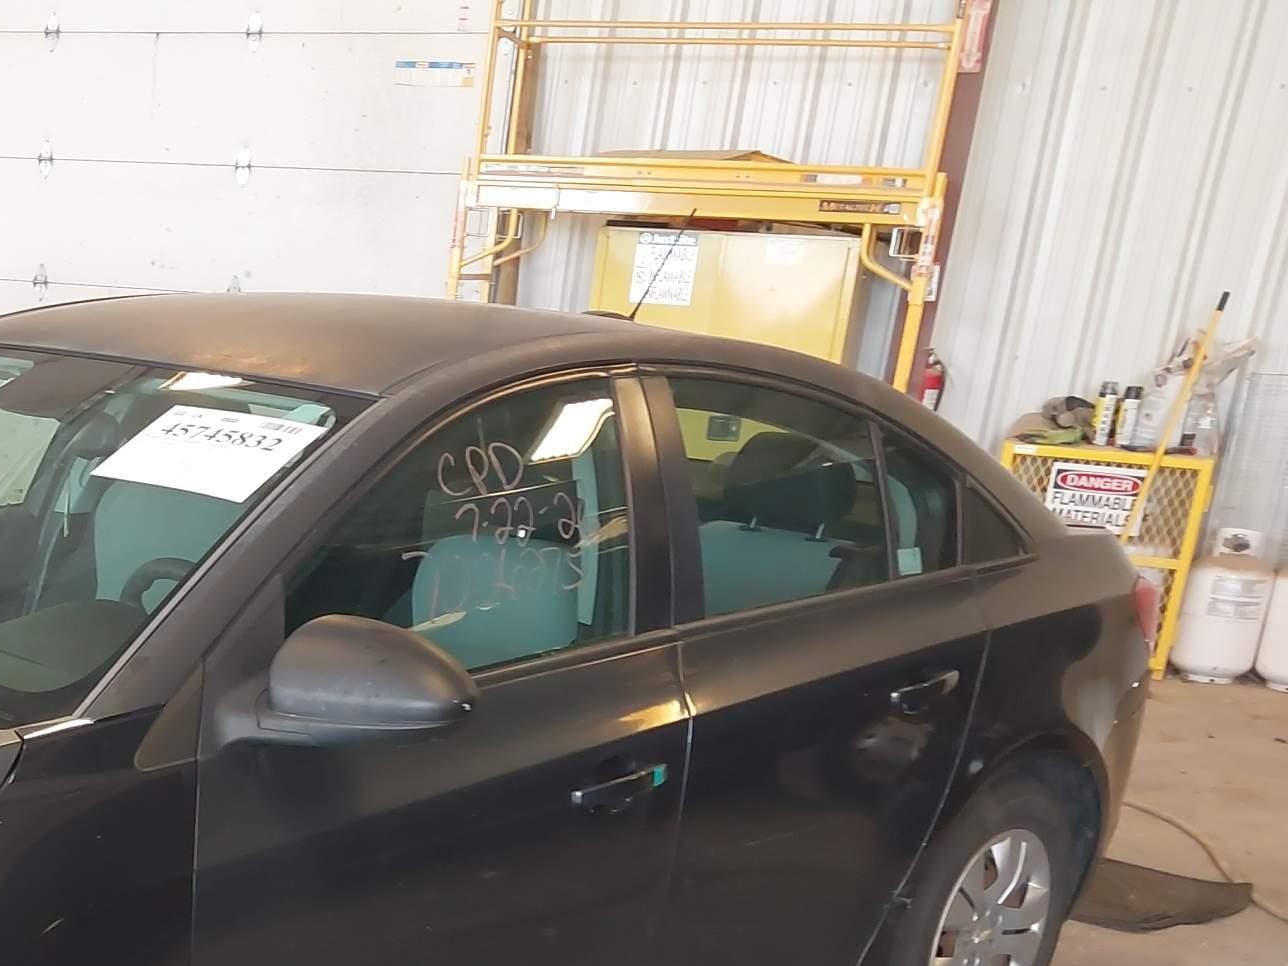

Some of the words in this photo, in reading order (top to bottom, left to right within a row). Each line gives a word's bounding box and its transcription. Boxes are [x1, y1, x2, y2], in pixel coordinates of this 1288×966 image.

[159, 421, 283, 452] 45745832
[437, 442, 524, 496] CPD
[1065, 473, 1133, 492] DANGER
